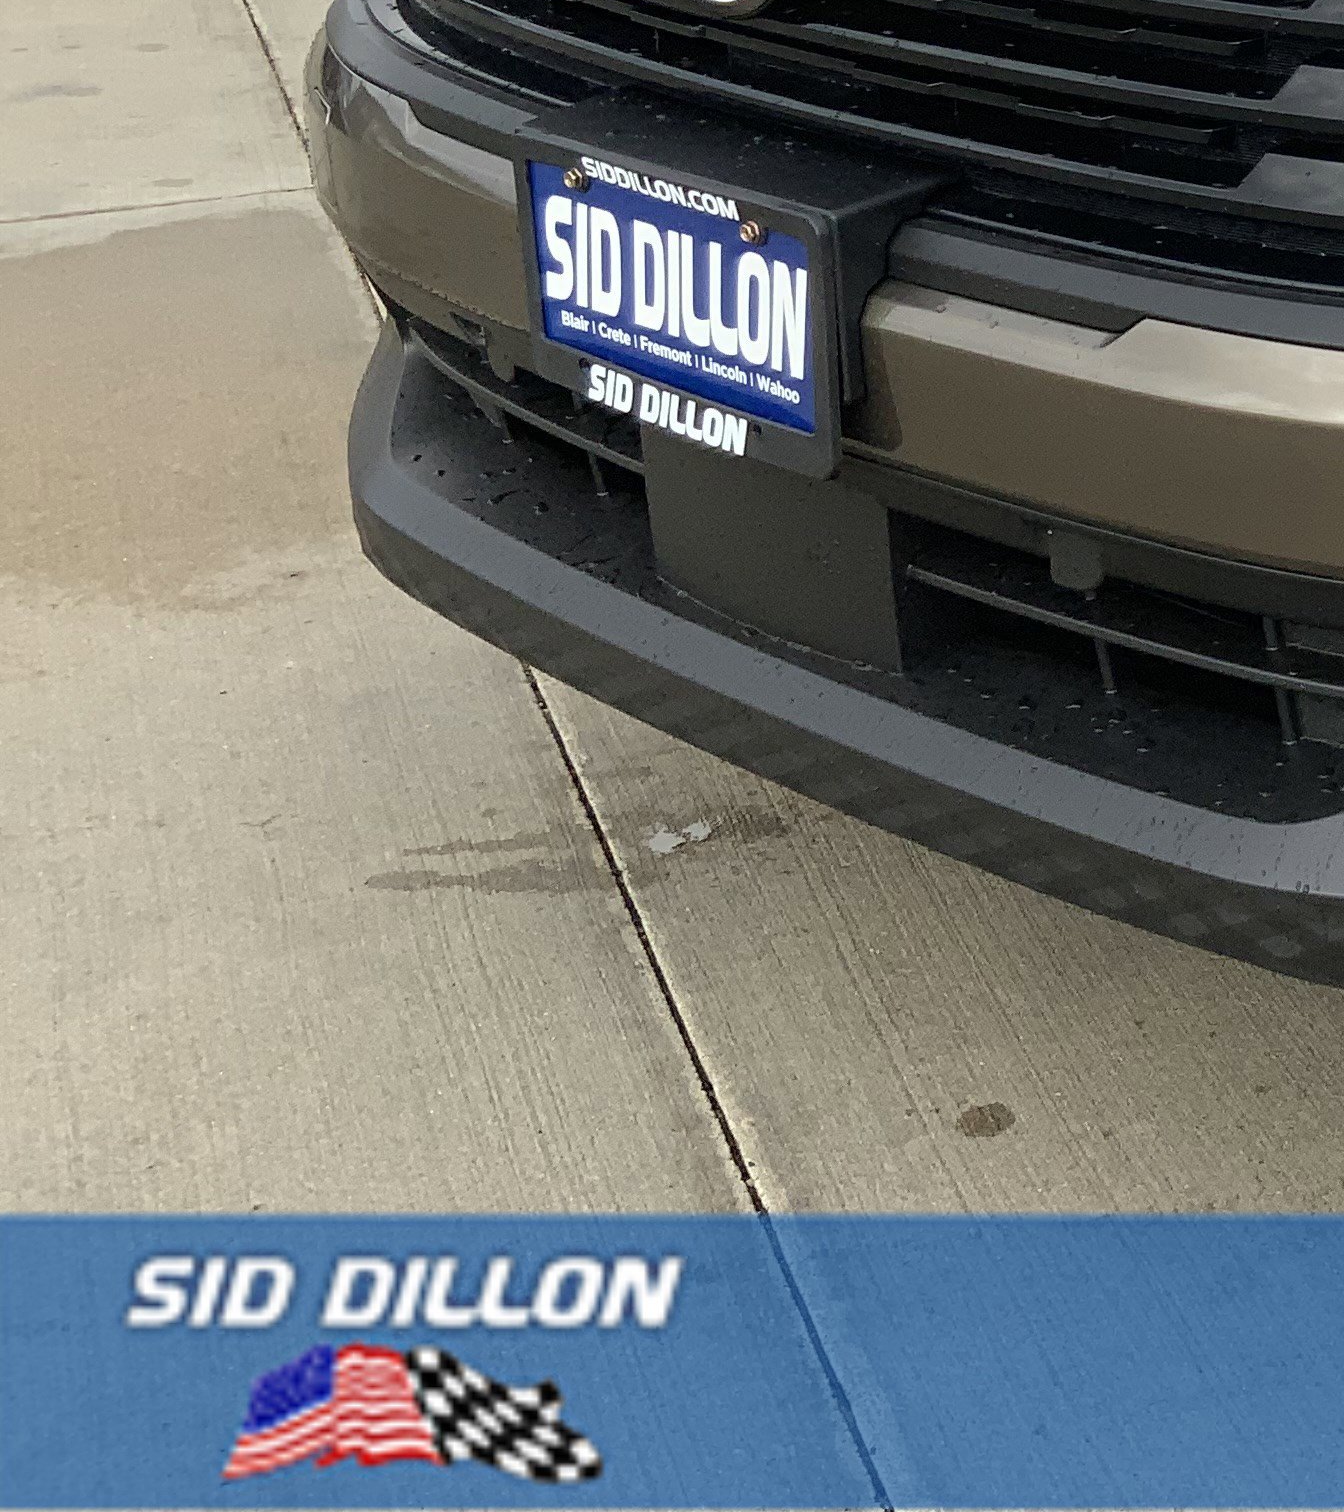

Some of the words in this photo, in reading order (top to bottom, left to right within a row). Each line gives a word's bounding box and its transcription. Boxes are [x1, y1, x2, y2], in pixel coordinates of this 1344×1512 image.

[580, 155, 740, 222] SIDDILLON.COM
[544, 193, 622, 318] SID
[632, 219, 808, 381] DILLON
[560, 308, 591, 335] Blair
[598, 322, 632, 347] Crete
[639, 334, 693, 369] Fremont
[701, 350, 748, 387] Lincoln
[756, 372, 801, 405] Wahoo
[588, 363, 634, 415] SID
[639, 382, 749, 457] DILLON
